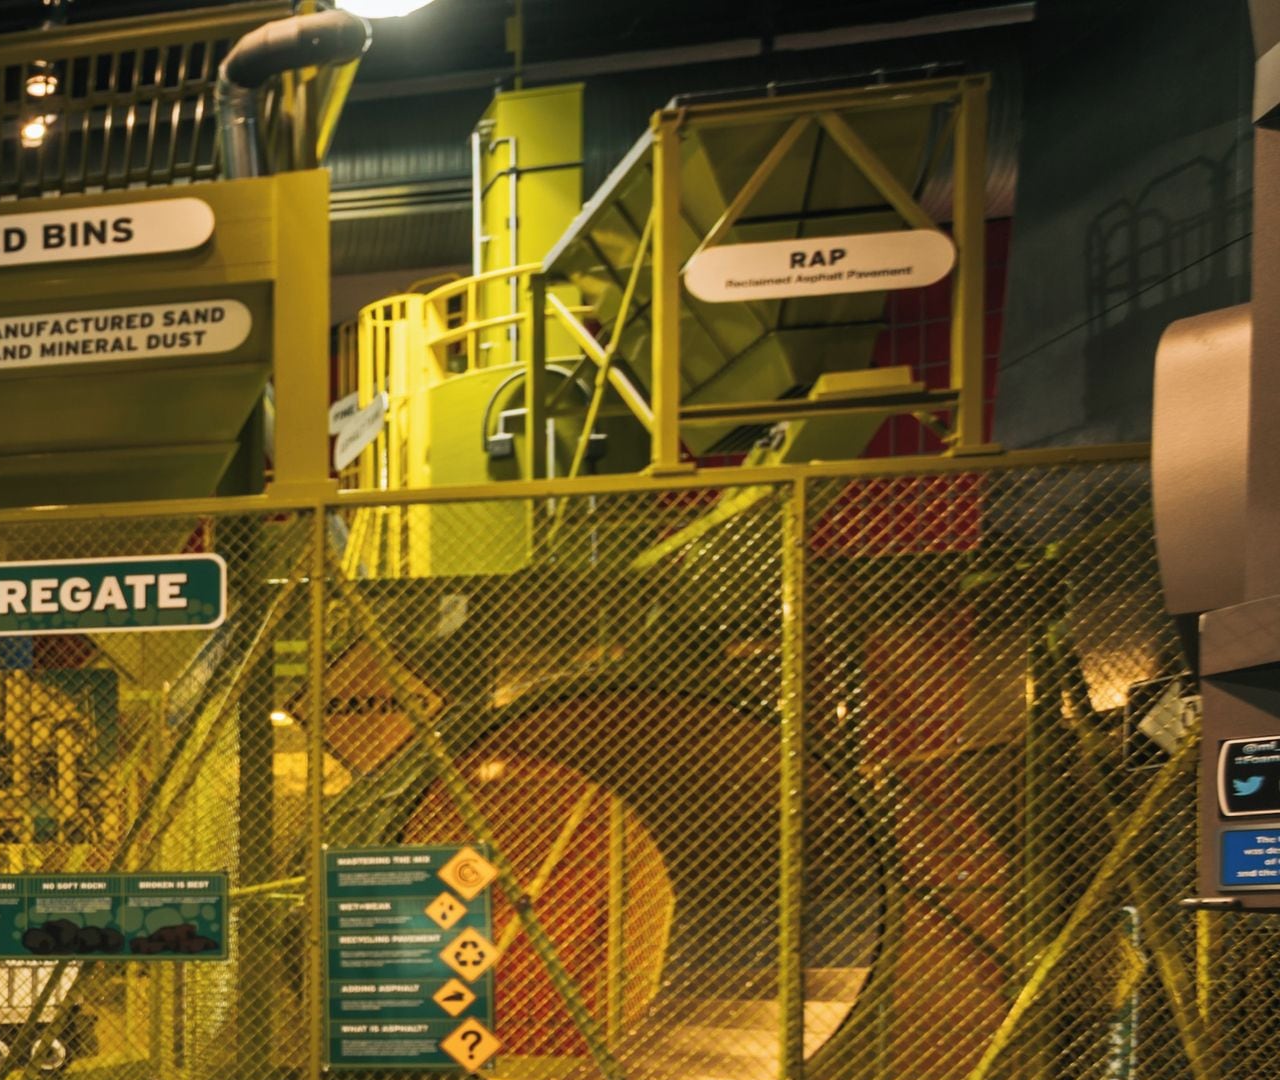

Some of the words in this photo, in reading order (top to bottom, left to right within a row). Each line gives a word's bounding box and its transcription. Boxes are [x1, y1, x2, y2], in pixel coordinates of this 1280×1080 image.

[42, 217, 134, 249] BINS
[790, 248, 848, 270] RAP
[725, 275, 792, 289] Reclaimed
[794, 271, 844, 286] Asphalt
[847, 265, 914, 280] Pavement
[162, 305, 226, 327] SAND
[40, 337, 139, 359] MINERAL
[145, 330, 208, 350] DUST
[42, 881, 55, 890] NO
[57, 881, 78, 890] SOFT
[138, 880, 175, 890] BROKEN
